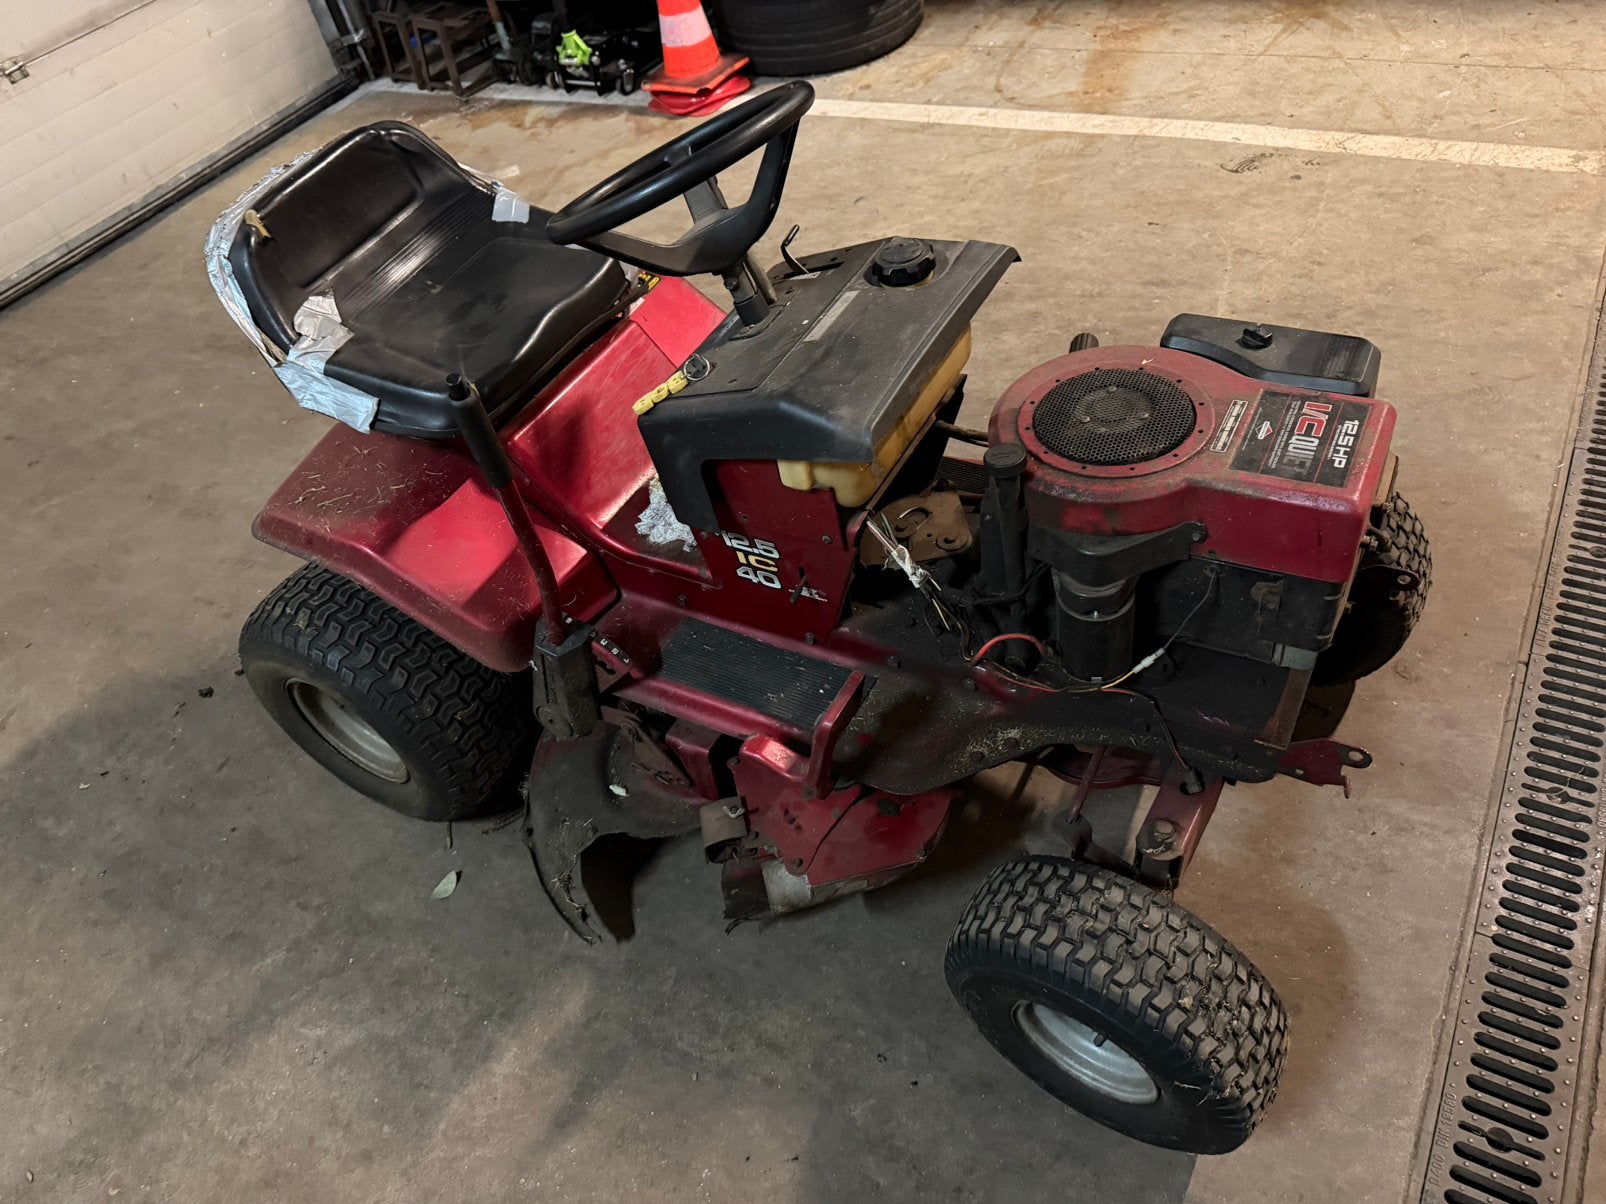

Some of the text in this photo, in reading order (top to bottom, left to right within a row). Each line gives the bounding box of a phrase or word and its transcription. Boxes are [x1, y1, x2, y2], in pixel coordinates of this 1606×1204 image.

[720, 529, 780, 559] 12.5
[736, 550, 778, 572] IC
[736, 565, 782, 589] 40
